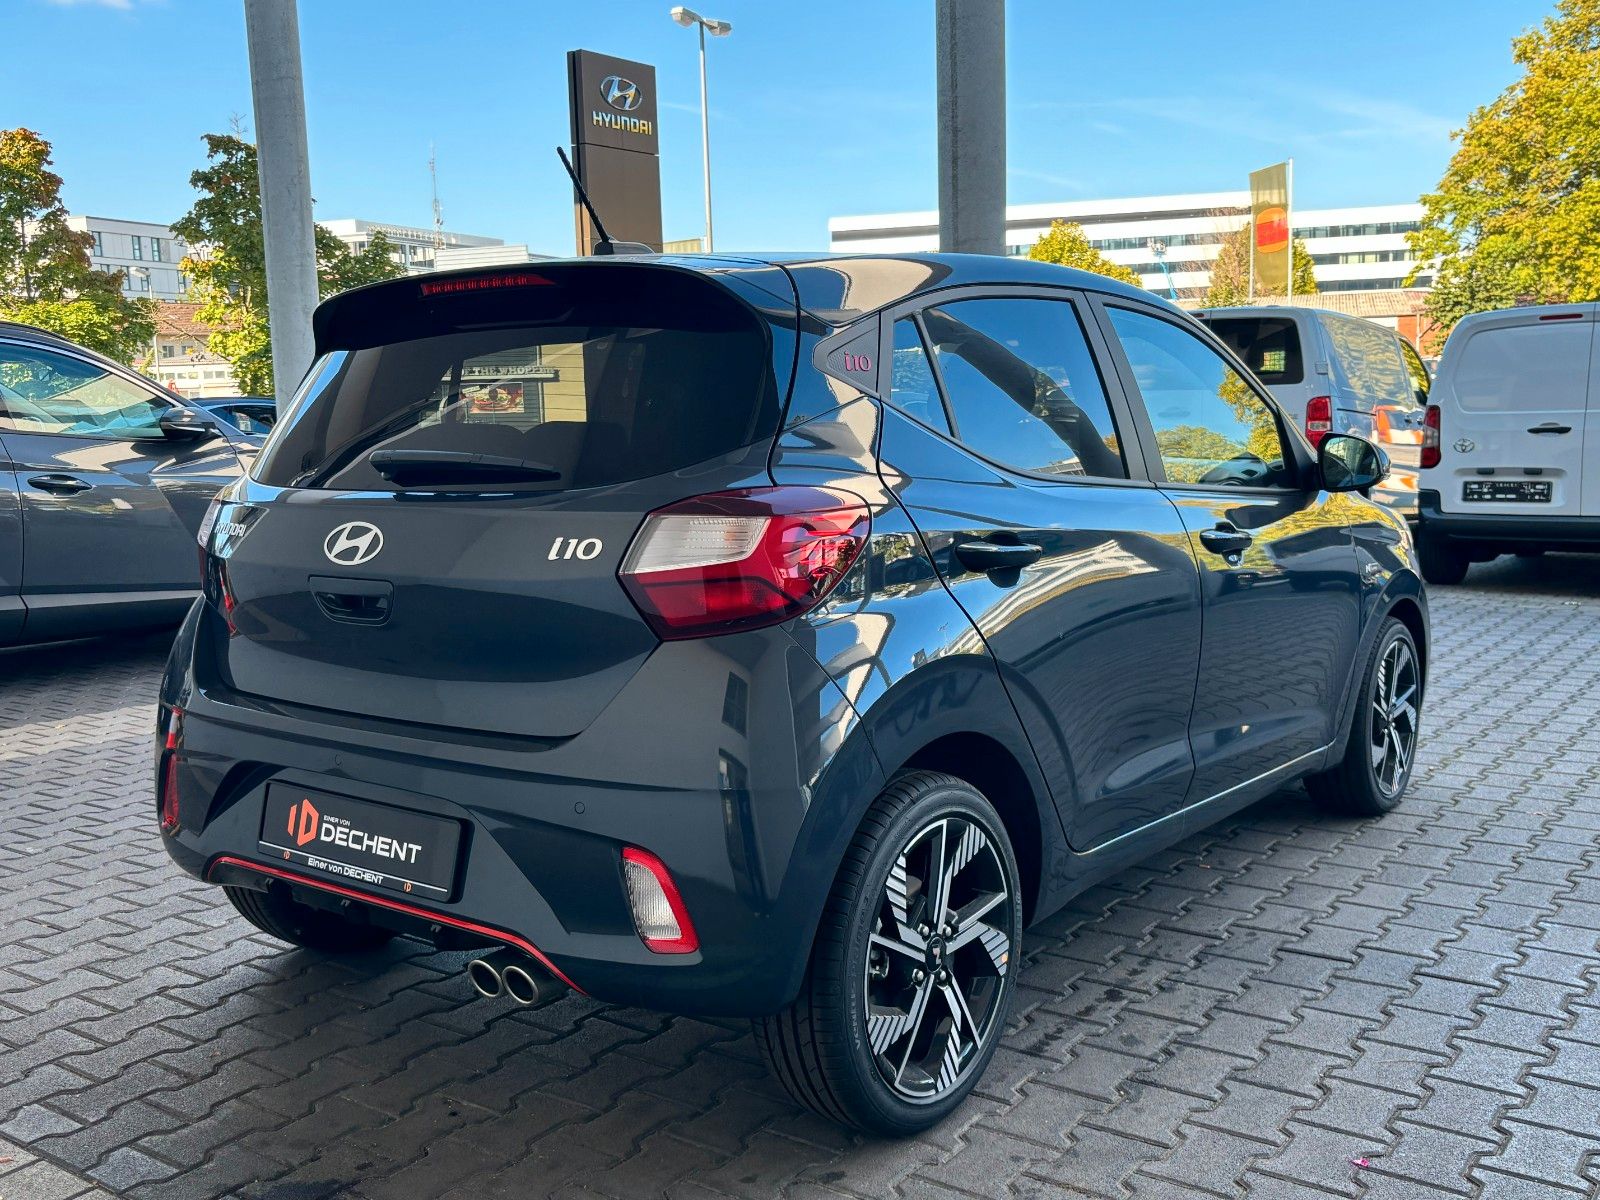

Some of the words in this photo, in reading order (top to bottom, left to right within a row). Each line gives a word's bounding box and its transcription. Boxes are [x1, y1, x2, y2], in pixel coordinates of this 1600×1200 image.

[592, 110, 652, 136] HYUNDAI
[472, 366, 496, 376] THE
[214, 522, 247, 537] HYUNDAI
[323, 814, 339, 824] EINER
[339, 818, 351, 827] VON
[320, 822, 422, 864] DECHENT
[308, 857, 328, 870] Einer
[328, 865, 342, 875] von
[343, 866, 384, 885] DECHENT
